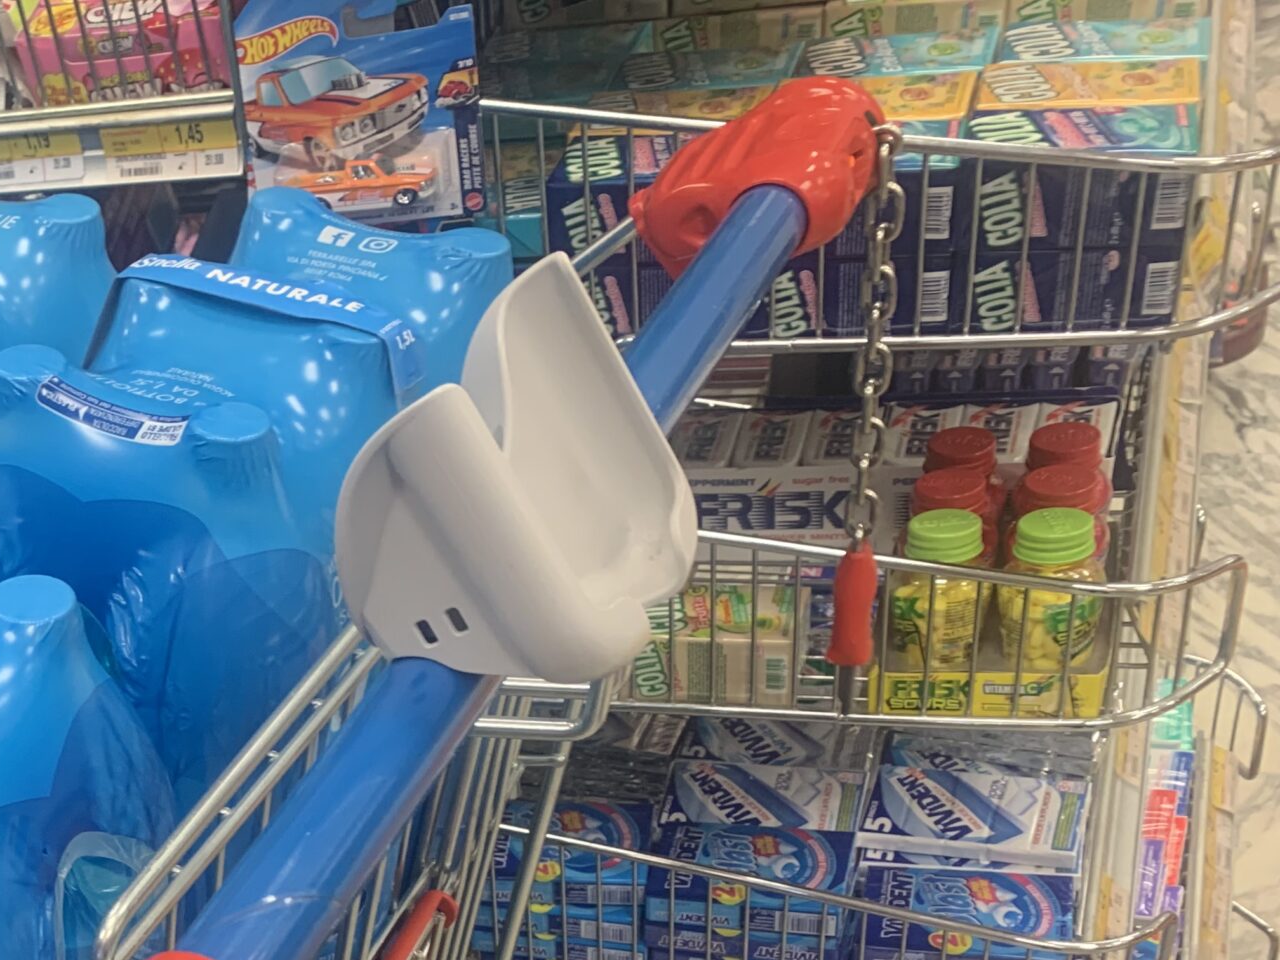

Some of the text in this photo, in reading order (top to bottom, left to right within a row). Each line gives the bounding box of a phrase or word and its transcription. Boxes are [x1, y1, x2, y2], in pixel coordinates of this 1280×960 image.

[242, 33, 277, 64] HOT
[174, 123, 204, 148] 1,45
[460, 137, 470, 168] RACERS
[473, 168, 482, 189] PISTE
[204, 267, 365, 314] NATURALE
[689, 478, 756, 487] EPPERMINT
[695, 490, 852, 530] FRISK
[889, 697, 961, 710] SOURS
[892, 679, 970, 698] FRISK
[720, 717, 781, 765] VIVIDE
[897, 773, 974, 840] VIVIDENT
